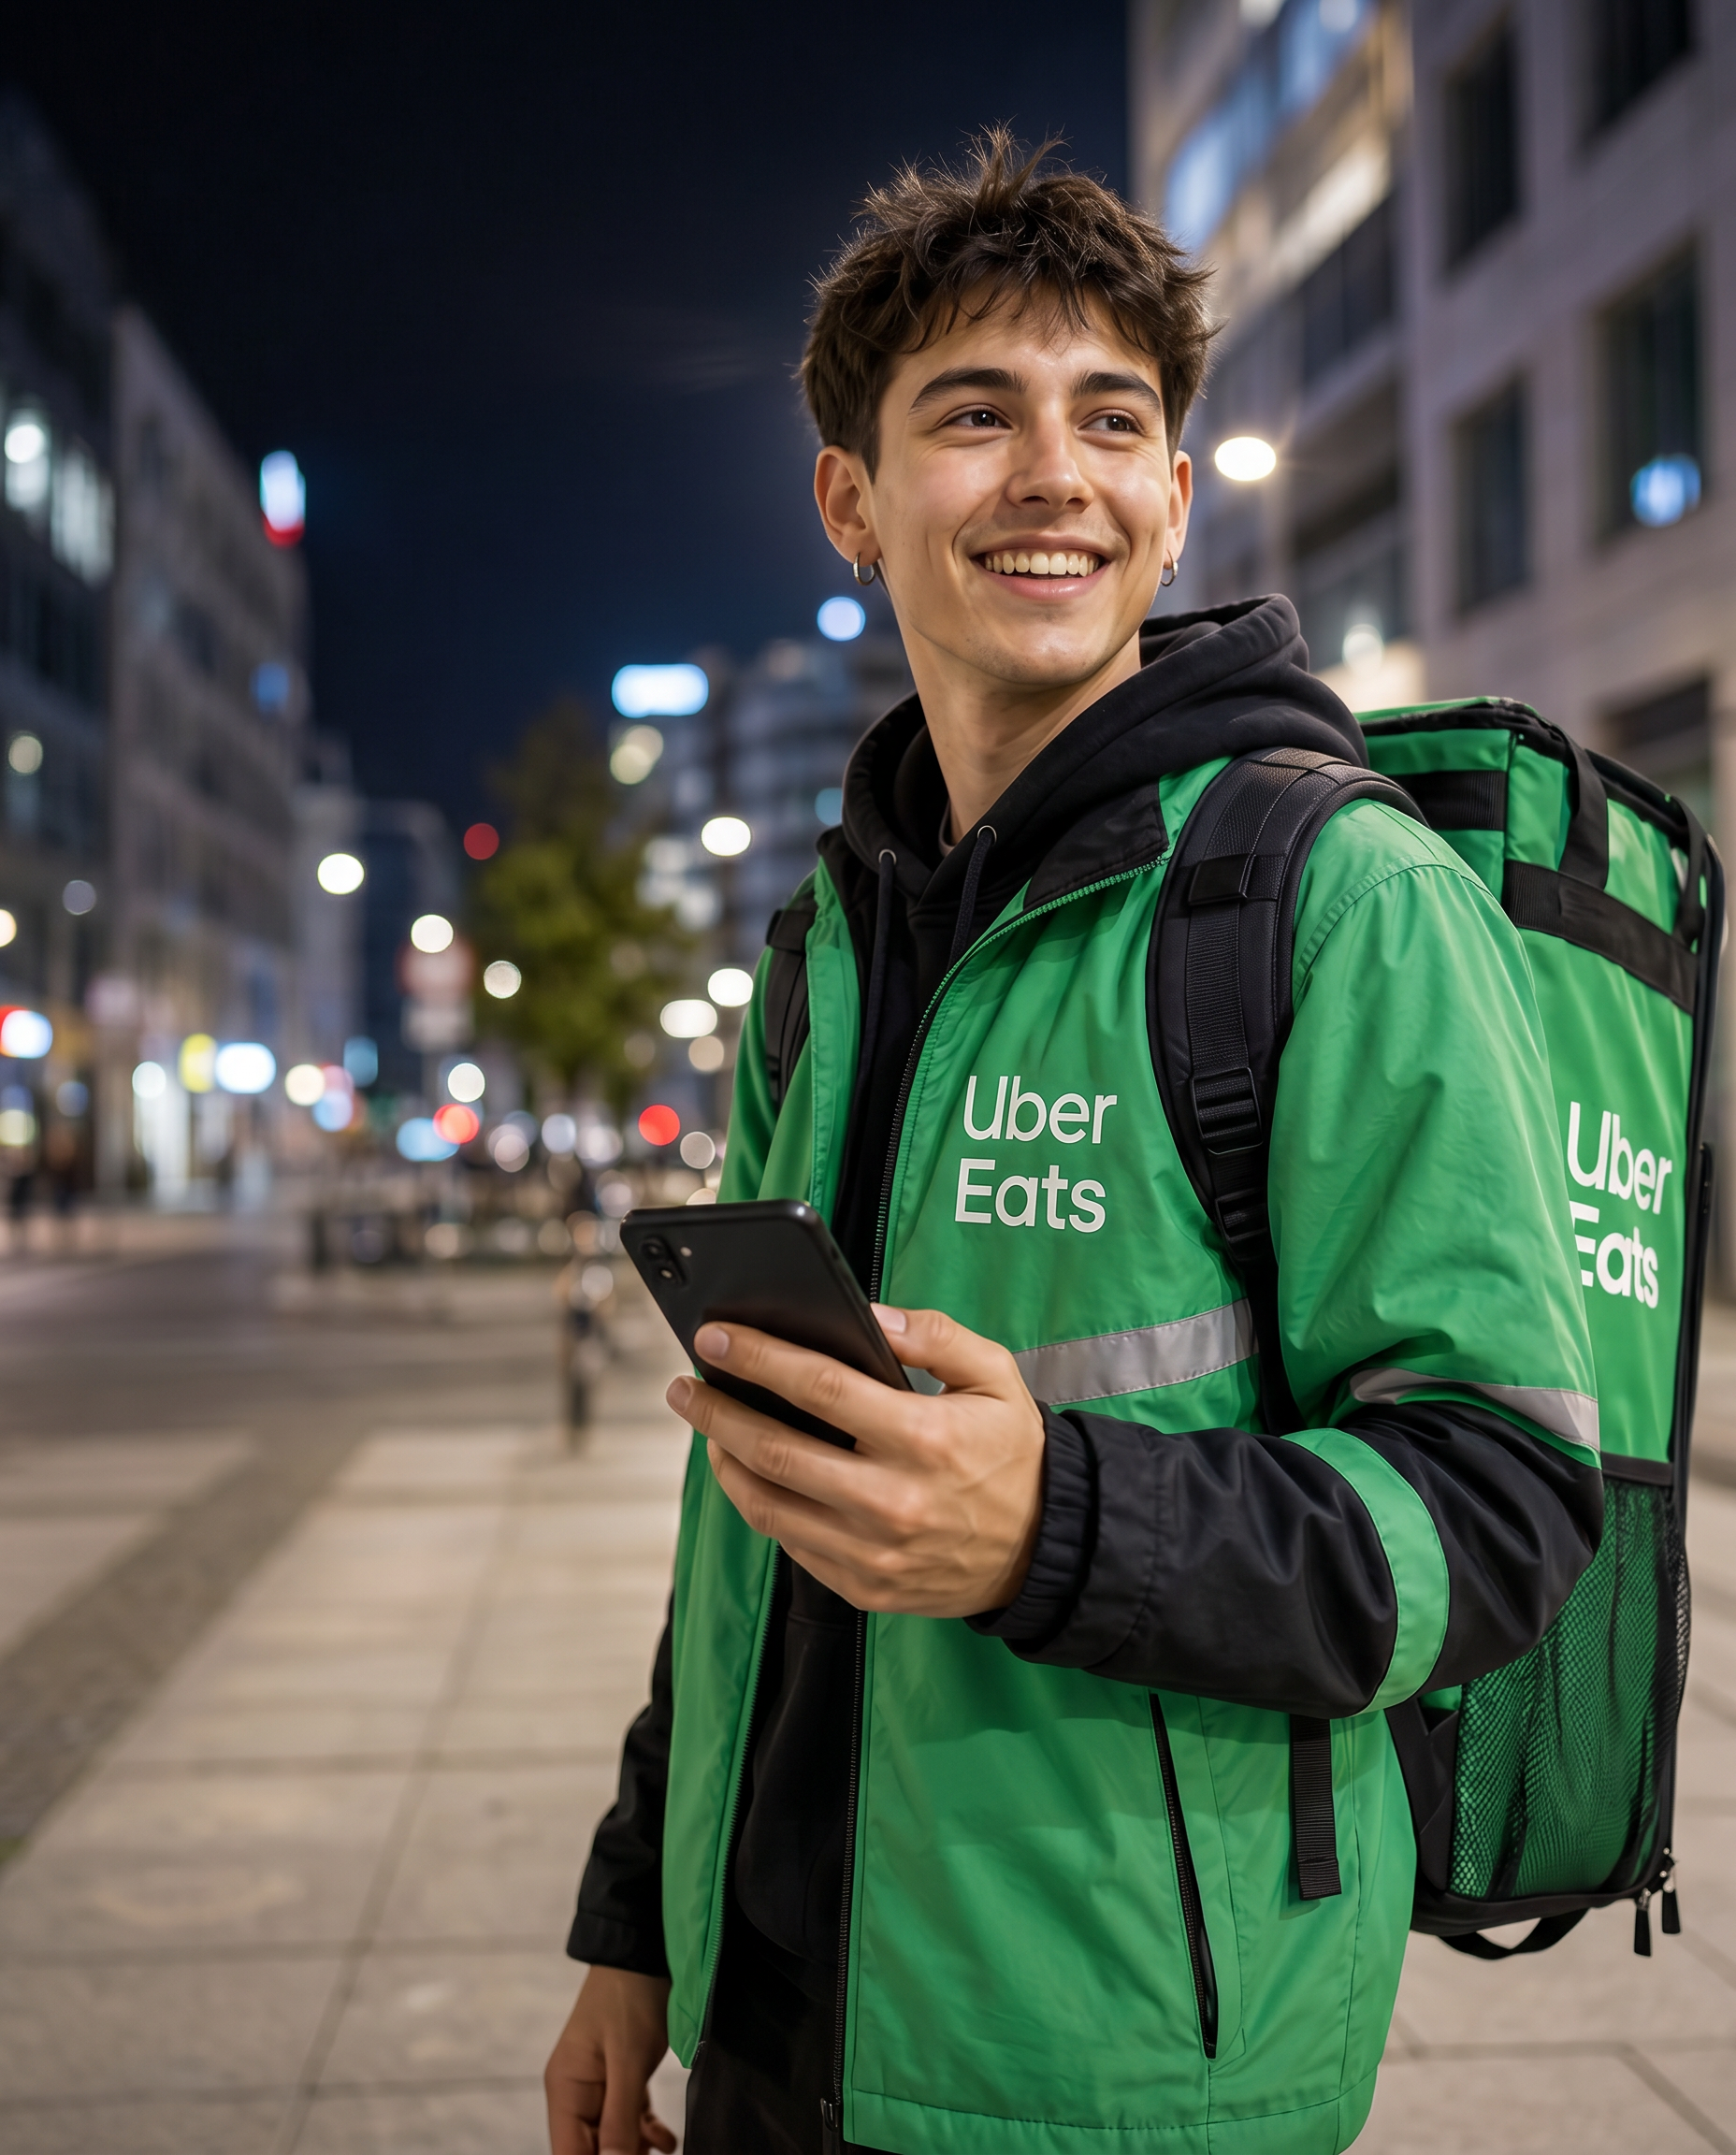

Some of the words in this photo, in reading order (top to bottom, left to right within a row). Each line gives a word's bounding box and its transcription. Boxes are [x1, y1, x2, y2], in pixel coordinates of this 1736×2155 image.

[962, 1075, 1118, 1144] Uber
[954, 1158, 1107, 1233] Eats
[1567, 1101, 1672, 1215] Uber
